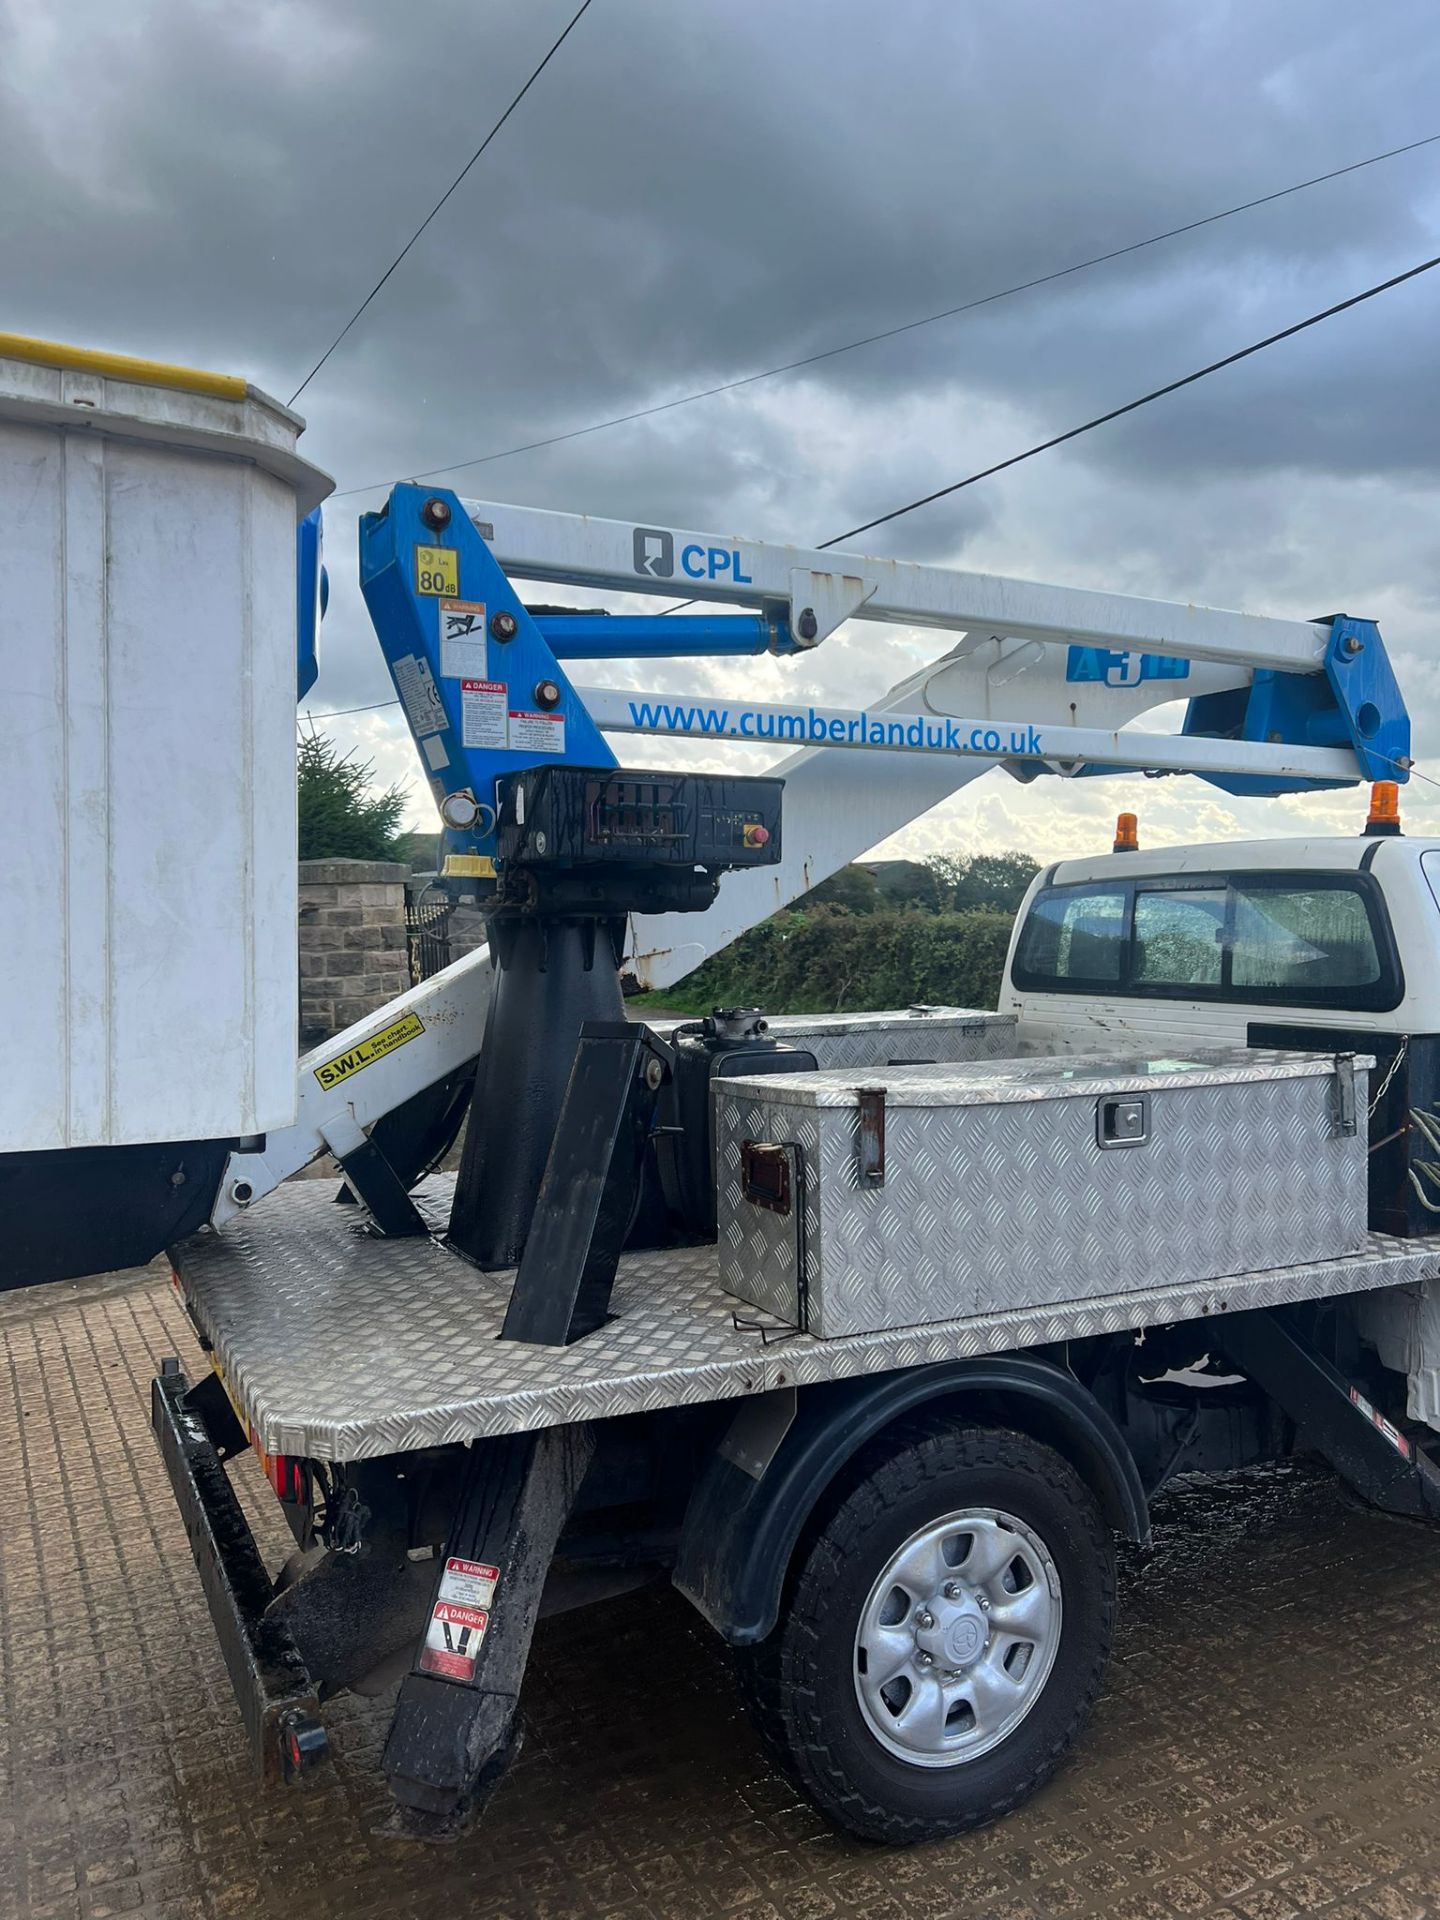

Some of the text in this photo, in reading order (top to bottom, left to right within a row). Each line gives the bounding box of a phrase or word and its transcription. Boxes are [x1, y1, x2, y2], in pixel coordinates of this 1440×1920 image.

[681, 544, 752, 584] CPL
[472, 683, 503, 691] DANGER
[628, 702, 1042, 754] www.cumberlanduk.co.uk
[371, 1025, 408, 1050] See chart
[374, 1024, 421, 1056] in handbook
[320, 1049, 375, 1084] S.W.L.
[462, 1563, 493, 1577] WARNING
[450, 1609, 484, 1625] DANGER
